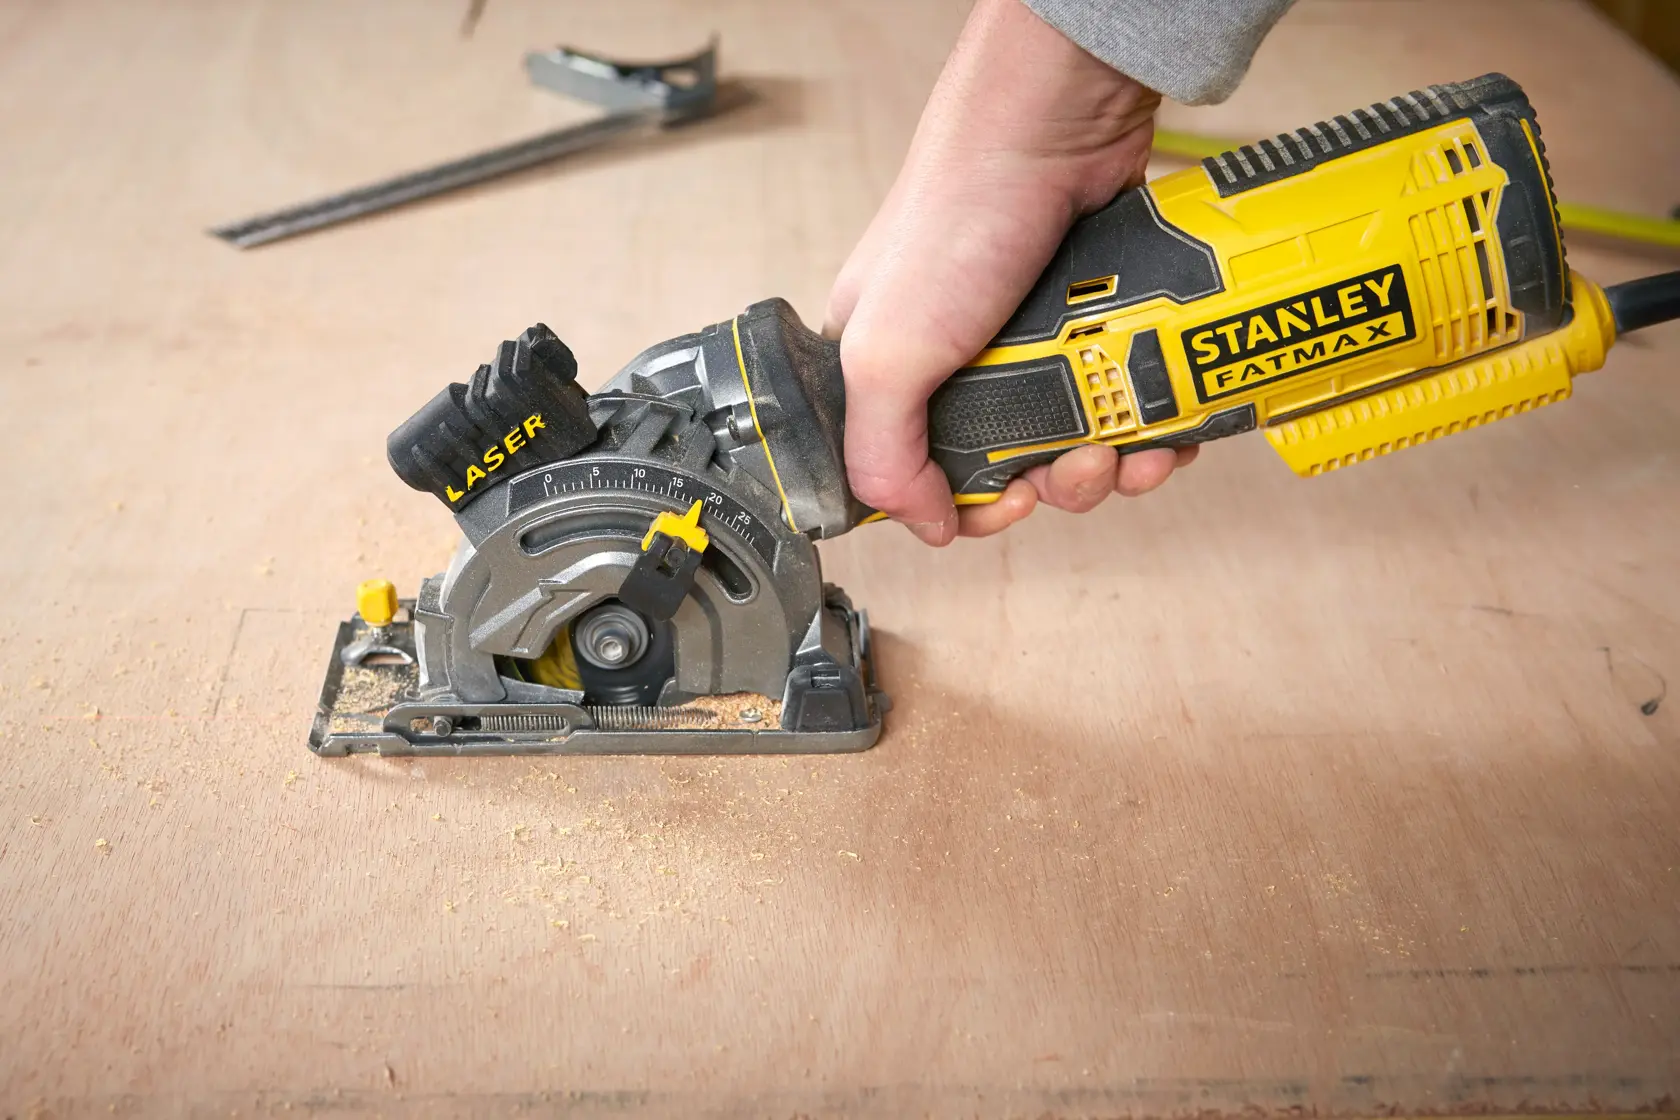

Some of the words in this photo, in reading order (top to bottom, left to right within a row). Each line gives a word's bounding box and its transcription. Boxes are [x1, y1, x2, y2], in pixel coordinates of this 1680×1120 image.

[1191, 272, 1395, 365] STANLEY
[1216, 320, 1391, 388] FATMAX
[445, 412, 546, 502] LASER
[544, 473, 552, 483] 0
[592, 467, 600, 476] 5
[634, 468, 646, 478] 10
[672, 477, 684, 488] 15
[708, 492, 723, 505] 20
[737, 512, 752, 525] 25
